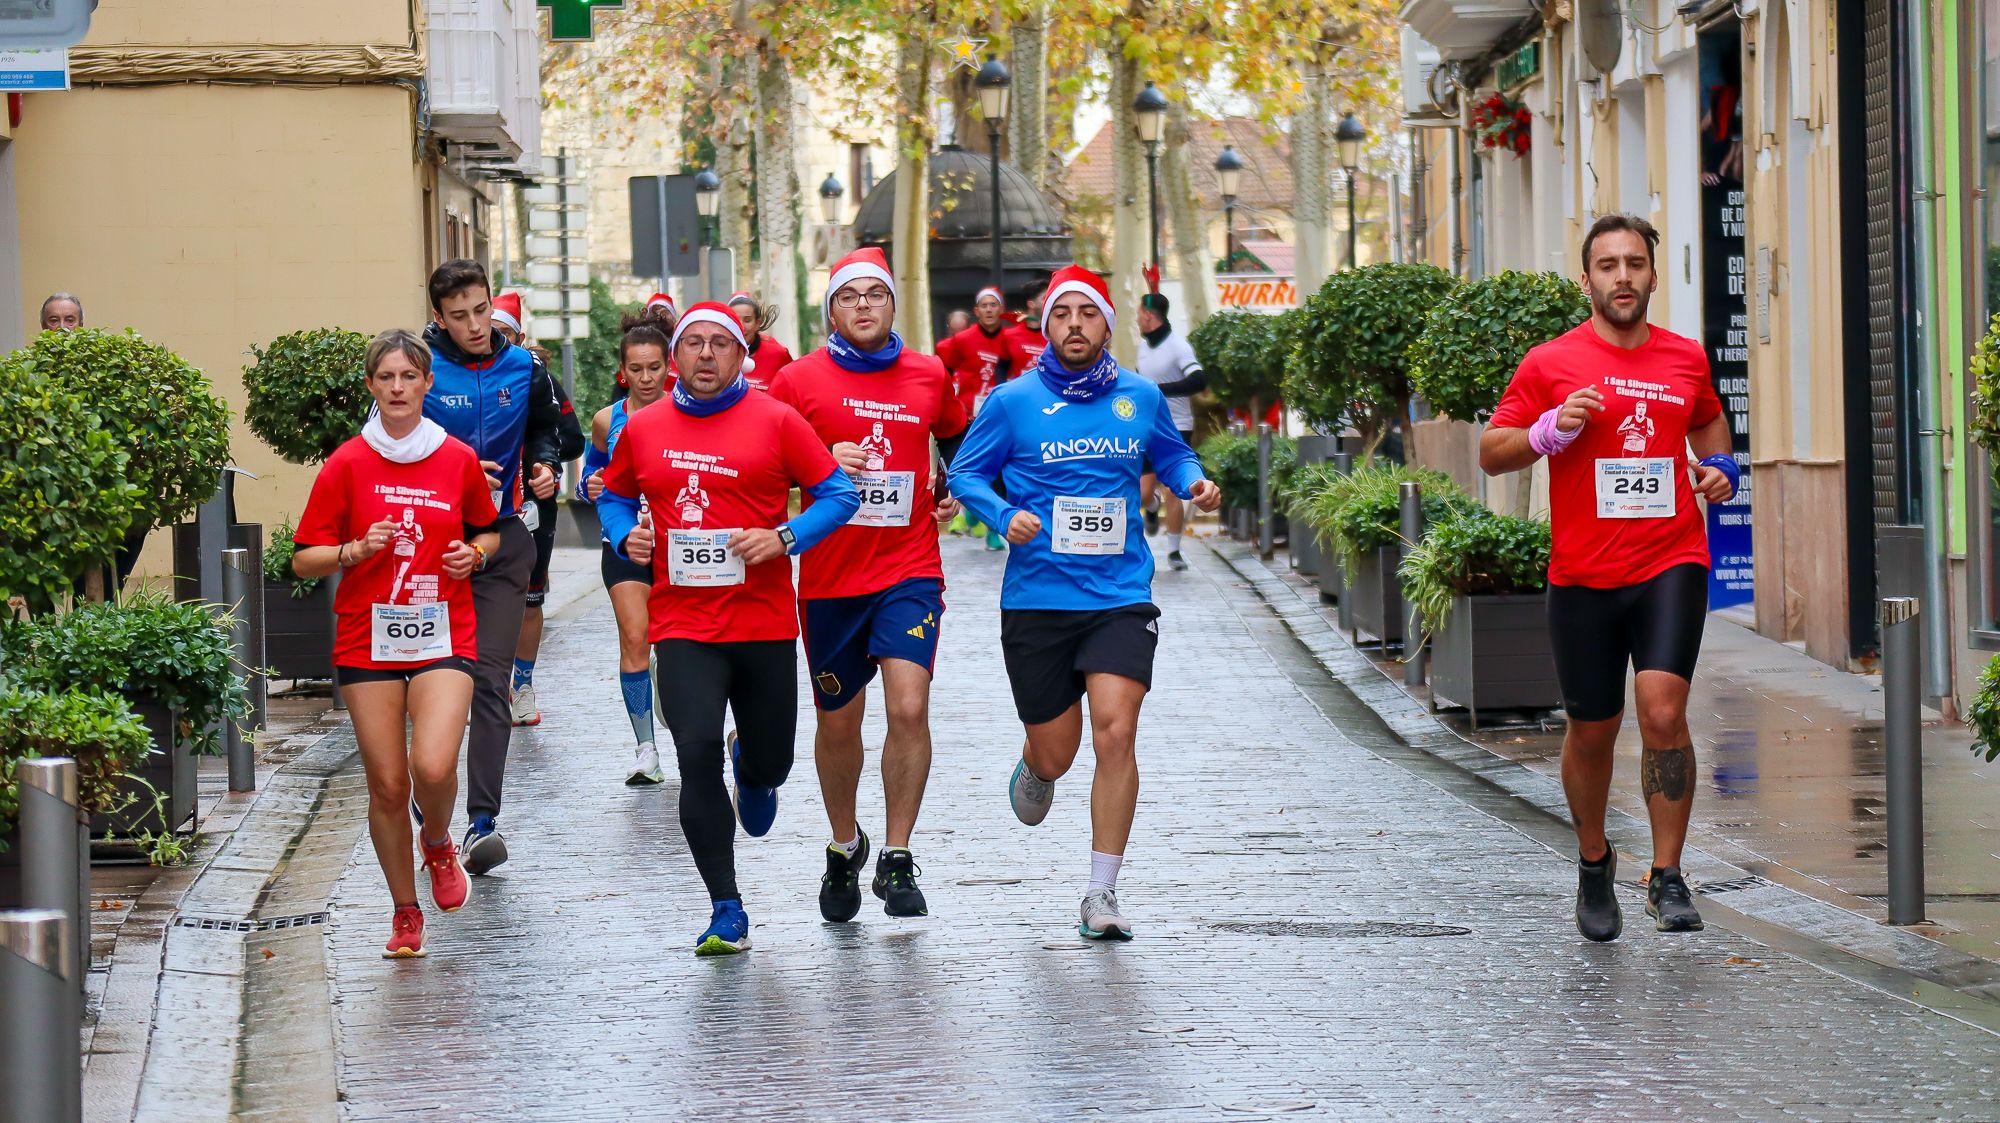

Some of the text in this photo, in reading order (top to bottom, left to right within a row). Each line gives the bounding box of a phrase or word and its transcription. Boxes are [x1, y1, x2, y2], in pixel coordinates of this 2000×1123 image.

[1721, 207, 1744, 222] DE D
[1722, 223, 1729, 237] Y
[1610, 377, 1626, 387] San
[1627, 379, 1664, 392] Silvestre
[445, 394, 472, 406] GTL
[1616, 386, 1685, 406] Ciudad de Lucena
[848, 398, 864, 408] San
[864, 400, 900, 412] Silvestre
[854, 408, 920, 424] Ciudad de Lucena
[668, 449, 682, 459] San
[683, 451, 718, 464] Silvestre
[671, 460, 738, 478] Ciudad de Lucena
[380, 485, 395, 494] San
[396, 486, 430, 497] Silvestre
[1614, 478, 1659, 494] 243
[384, 494, 451, 511] Ciudad de Lucena
[859, 489, 899, 505] 484
[1068, 516, 1113, 532] 359
[682, 548, 726, 564] 363
[387, 621, 435, 639] 602
